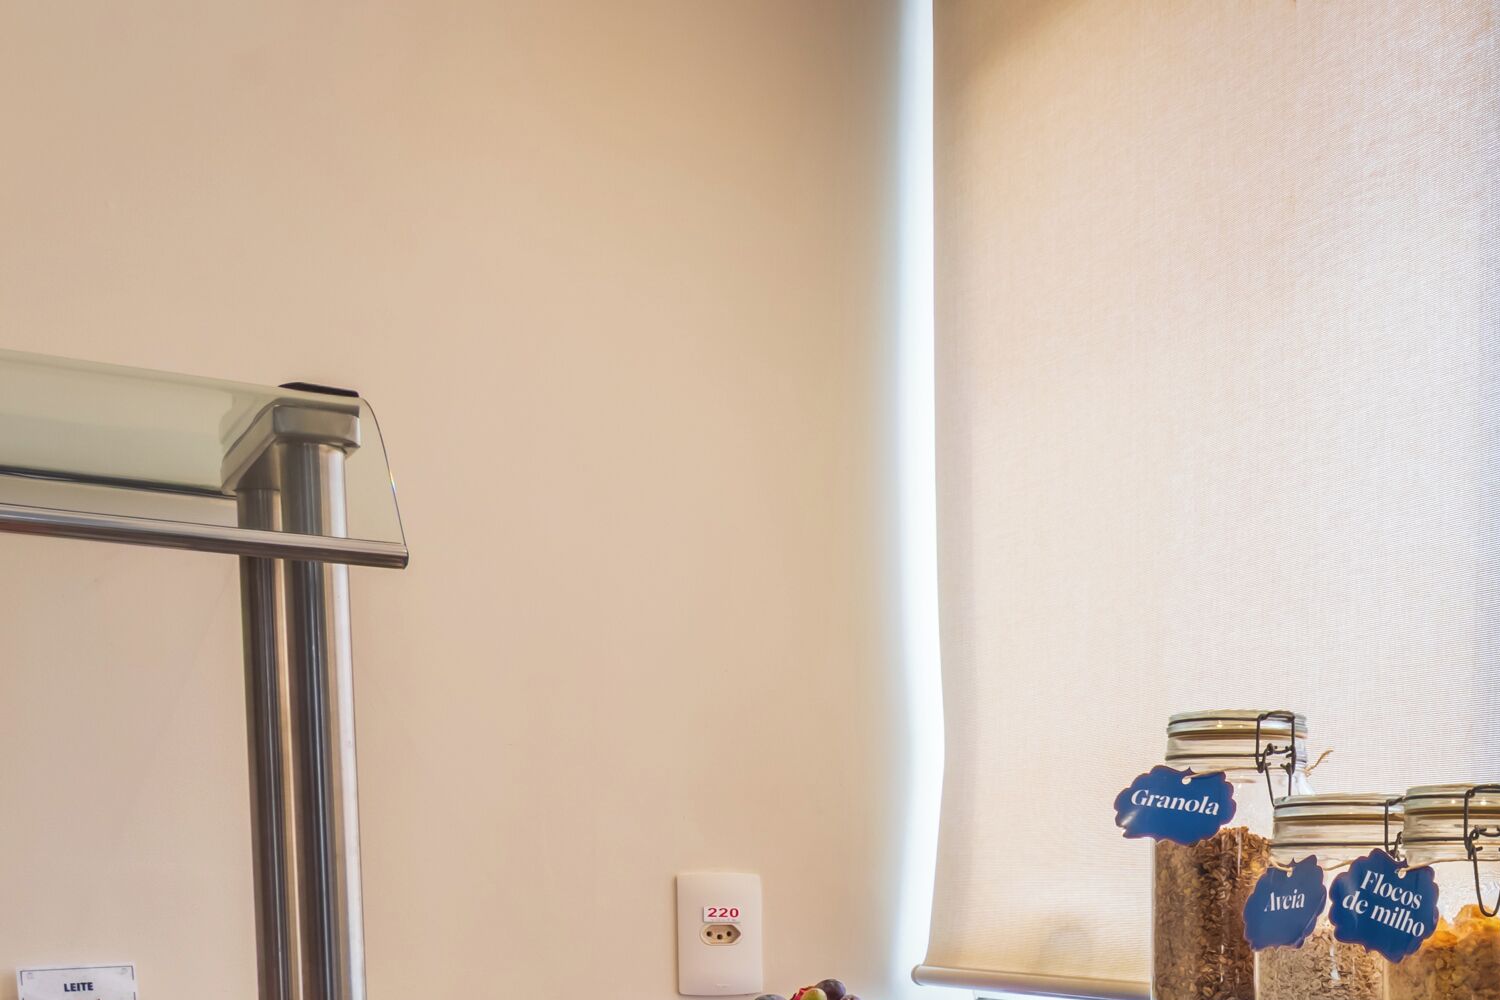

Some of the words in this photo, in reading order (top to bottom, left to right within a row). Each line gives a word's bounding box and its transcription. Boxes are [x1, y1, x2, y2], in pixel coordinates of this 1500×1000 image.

[1130, 789, 1220, 816] Granola
[1264, 889, 1305, 912] Aveia
[1360, 870, 1423, 910] Flocos
[707, 907, 739, 918] 220
[1342, 891, 1369, 915] de
[1371, 904, 1425, 937] milho
[64, 981, 94, 993] LEITE
